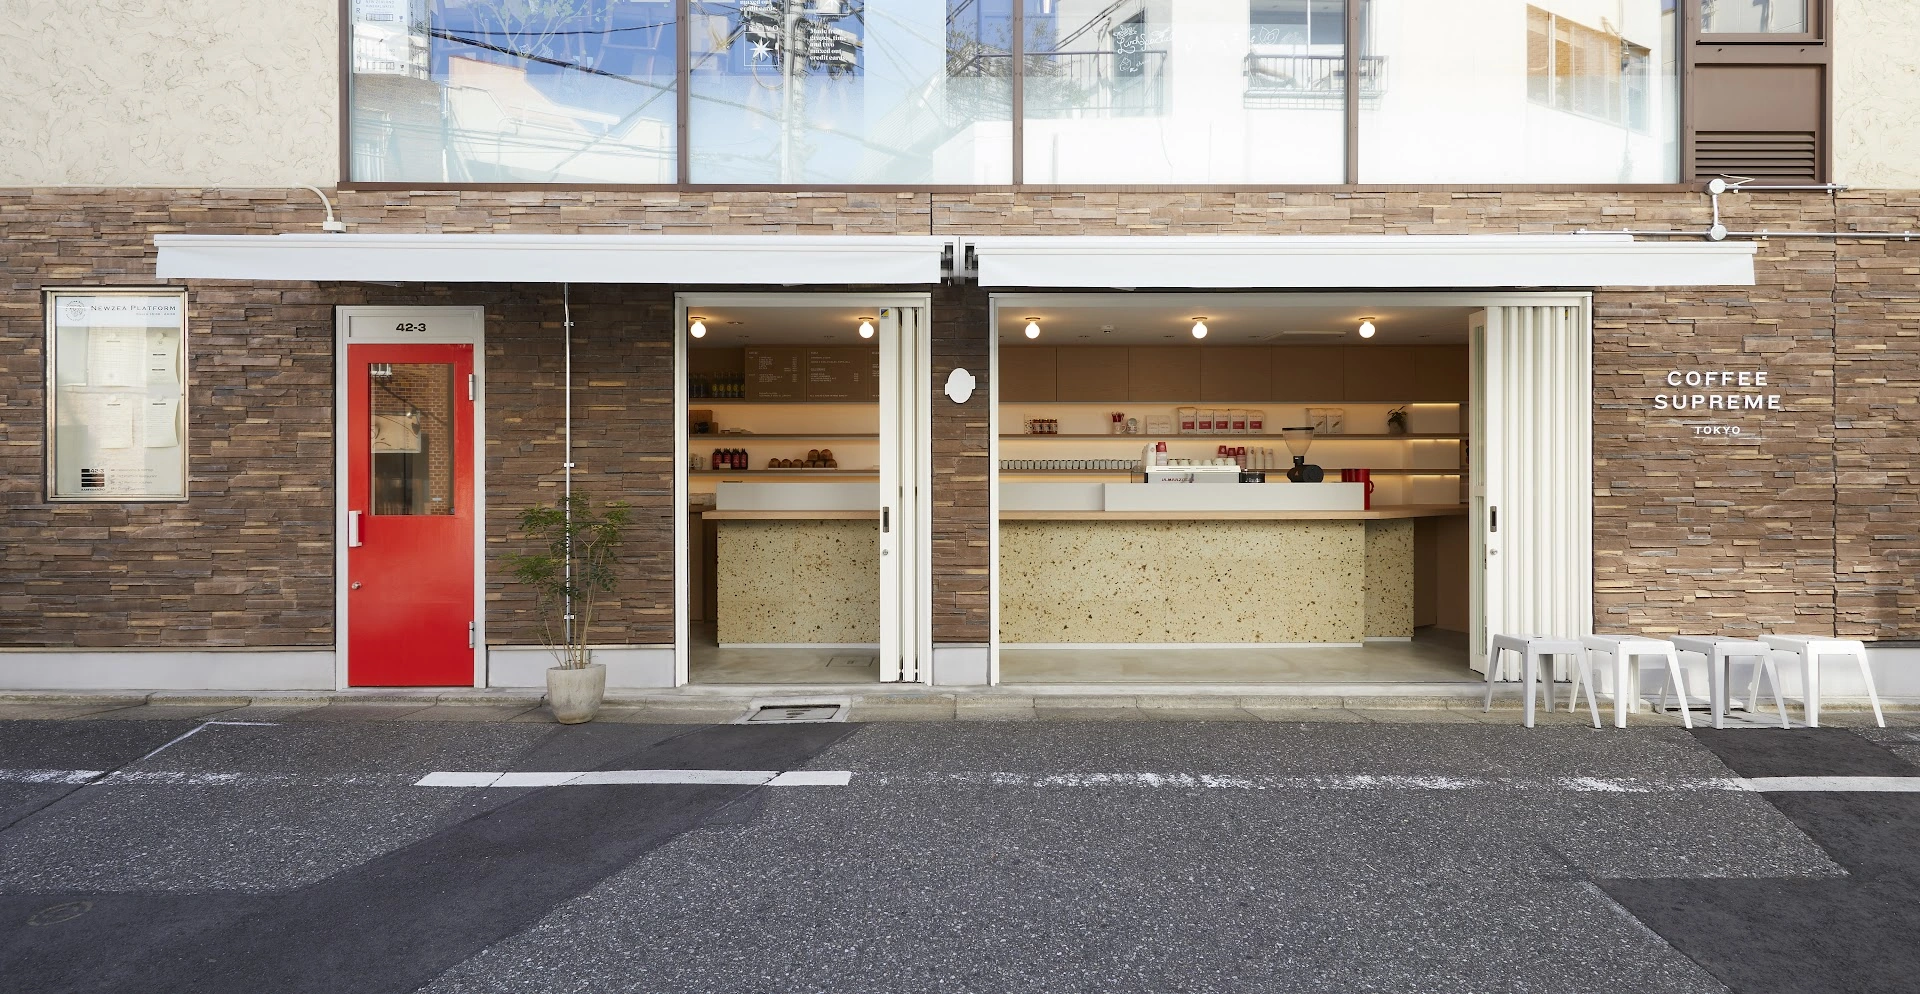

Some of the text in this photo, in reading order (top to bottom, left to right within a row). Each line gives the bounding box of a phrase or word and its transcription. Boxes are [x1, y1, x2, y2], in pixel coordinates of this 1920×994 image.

[395, 323, 427, 332] 42-3
[1667, 371, 1768, 386] COFFEE
[1653, 394, 1781, 410] SUPREME
[1695, 426, 1741, 435] TOKYO
